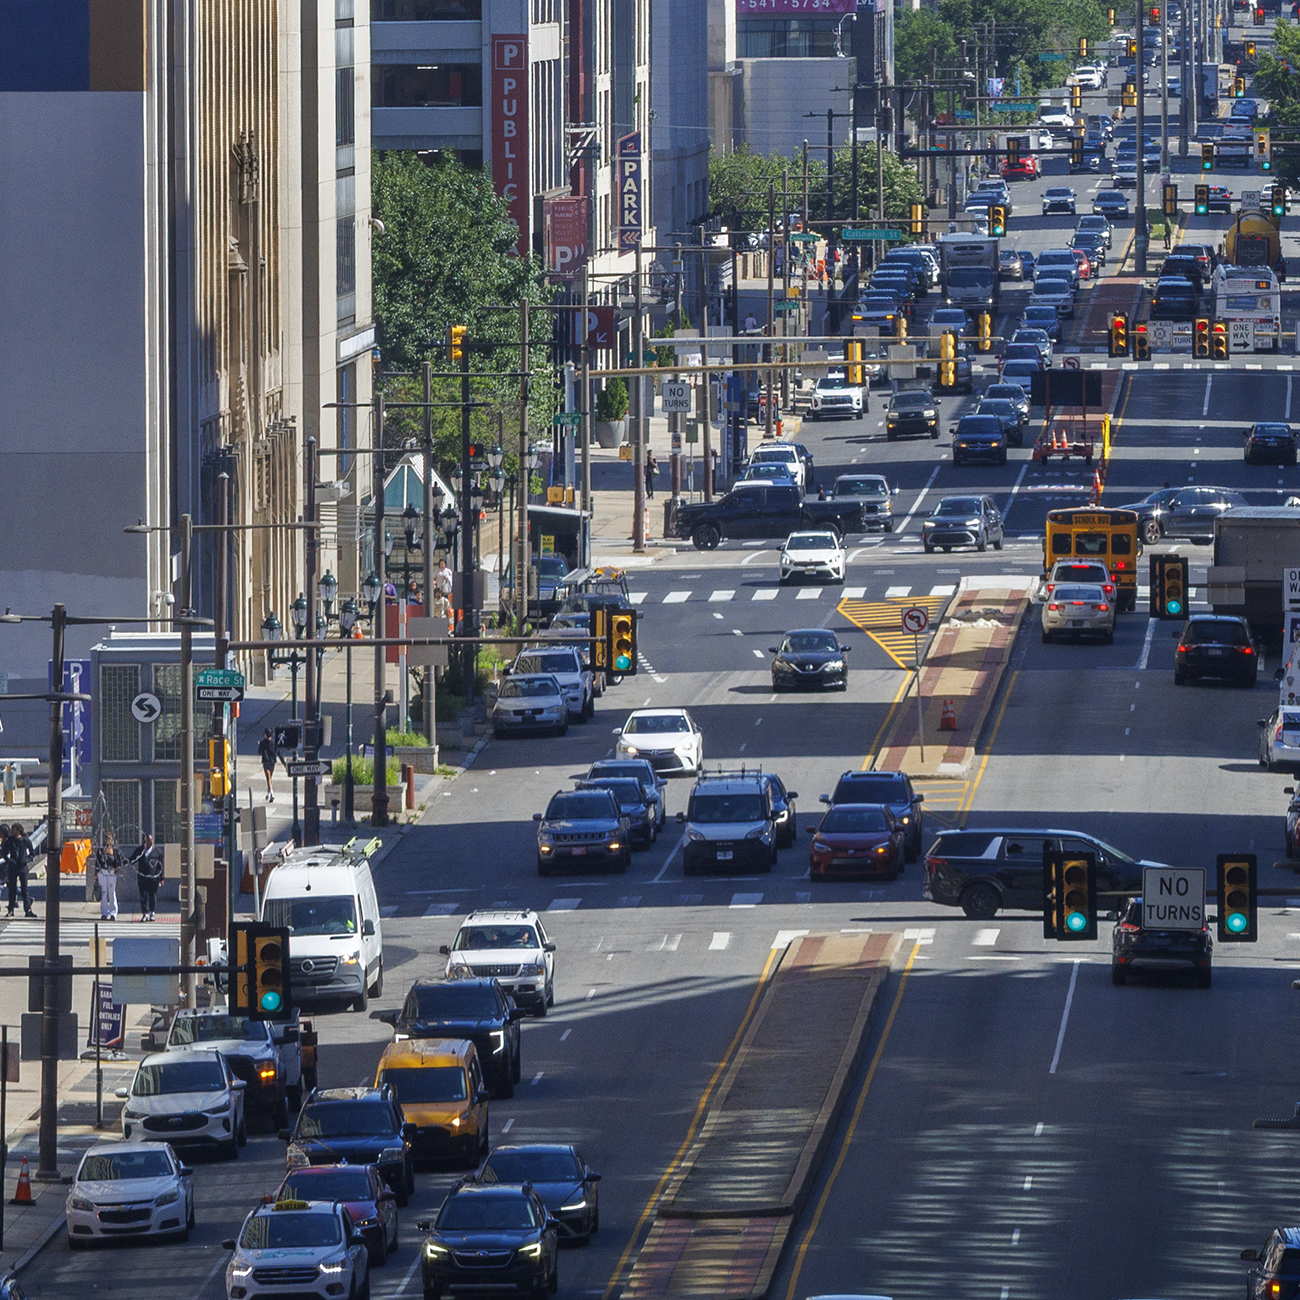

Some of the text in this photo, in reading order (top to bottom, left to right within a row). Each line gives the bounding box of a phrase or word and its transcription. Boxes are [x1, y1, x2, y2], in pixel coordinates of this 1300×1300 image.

[503, 43, 518, 66] P
[502, 77, 518, 201] PUBLIC
[622, 160, 640, 226] PARK
[845, 230, 898, 239] Callowhill St
[555, 246, 573, 272] P
[1232, 324, 1250, 332] ONE
[668, 387, 684, 397] NO
[664, 399, 689, 408] TURNS
[1074, 515, 1111, 525] SCHOOL BUS
[207, 674, 243, 685] Race St
[201, 689, 231, 697] ONE WAY
[1159, 877, 1189, 898] NO
[1146, 904, 1201, 922] TURNS
[102, 1001, 114, 1009] FULL
